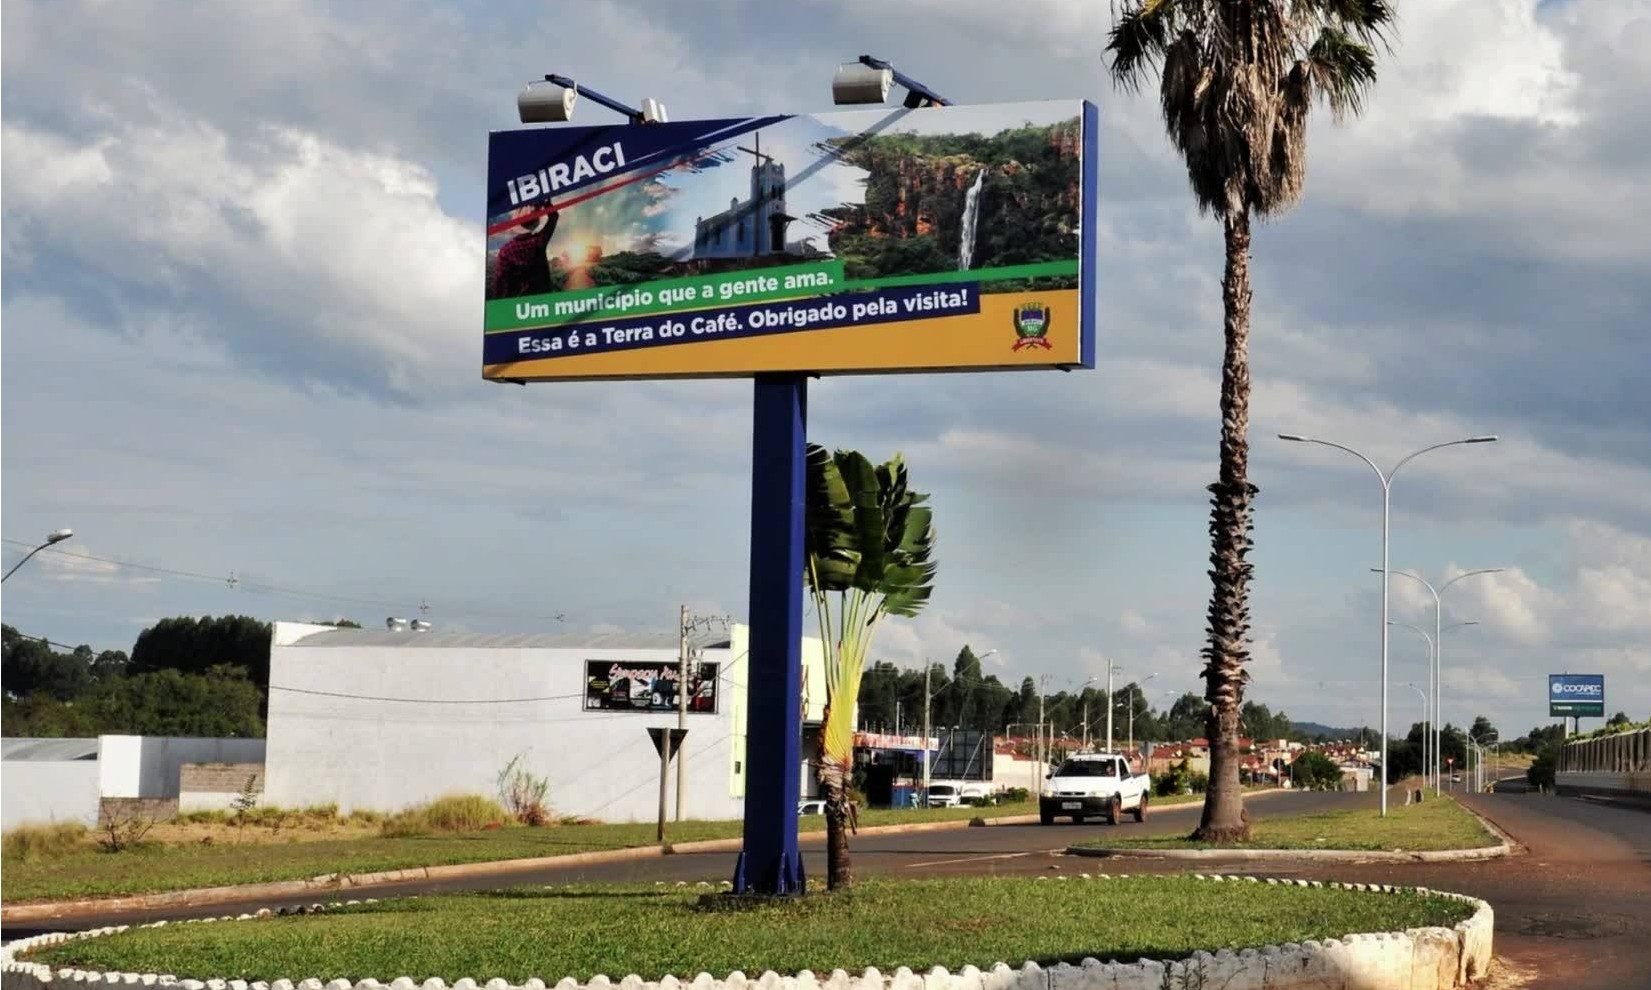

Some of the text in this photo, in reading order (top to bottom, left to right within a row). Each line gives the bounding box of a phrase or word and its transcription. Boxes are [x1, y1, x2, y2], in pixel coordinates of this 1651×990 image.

[506, 142, 626, 206] IBIRACI
[515, 270, 834, 320] Um município que a gente ama.
[518, 289, 968, 354] Essa é a Terra do Café. Obrigado pela visita!
